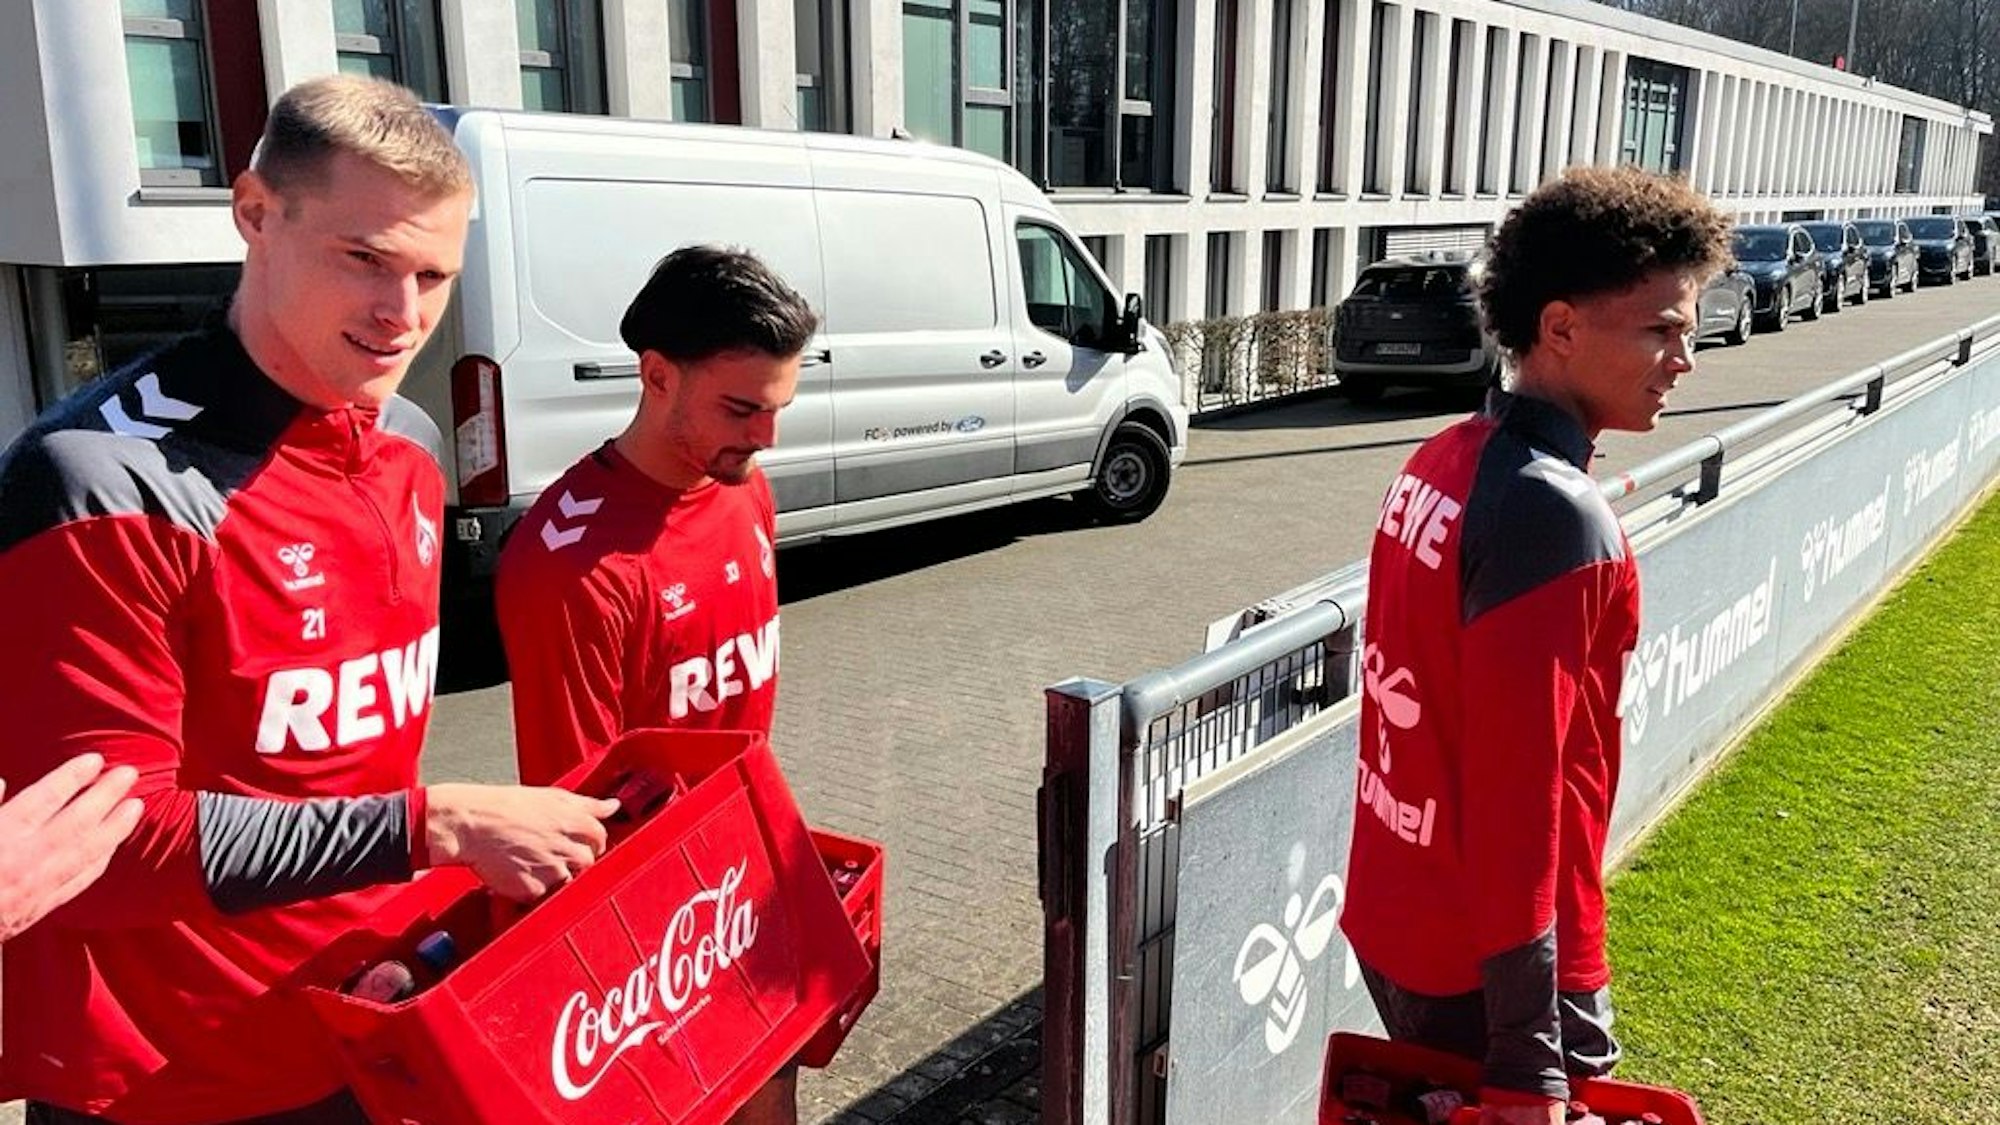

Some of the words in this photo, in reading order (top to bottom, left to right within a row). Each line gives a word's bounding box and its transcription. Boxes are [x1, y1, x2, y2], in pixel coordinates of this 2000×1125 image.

[864, 428, 880, 441] FC
[893, 420, 939, 438] powered
[941, 420, 953, 435] by
[1822, 474, 1891, 585] hummel
[302, 607, 326, 640] 21
[669, 614, 781, 720] REW
[1663, 555, 1777, 718] hummel
[254, 624, 440, 754] REW
[1358, 758, 1437, 847] ummel
[551, 855, 759, 1100] Coca-Cola
